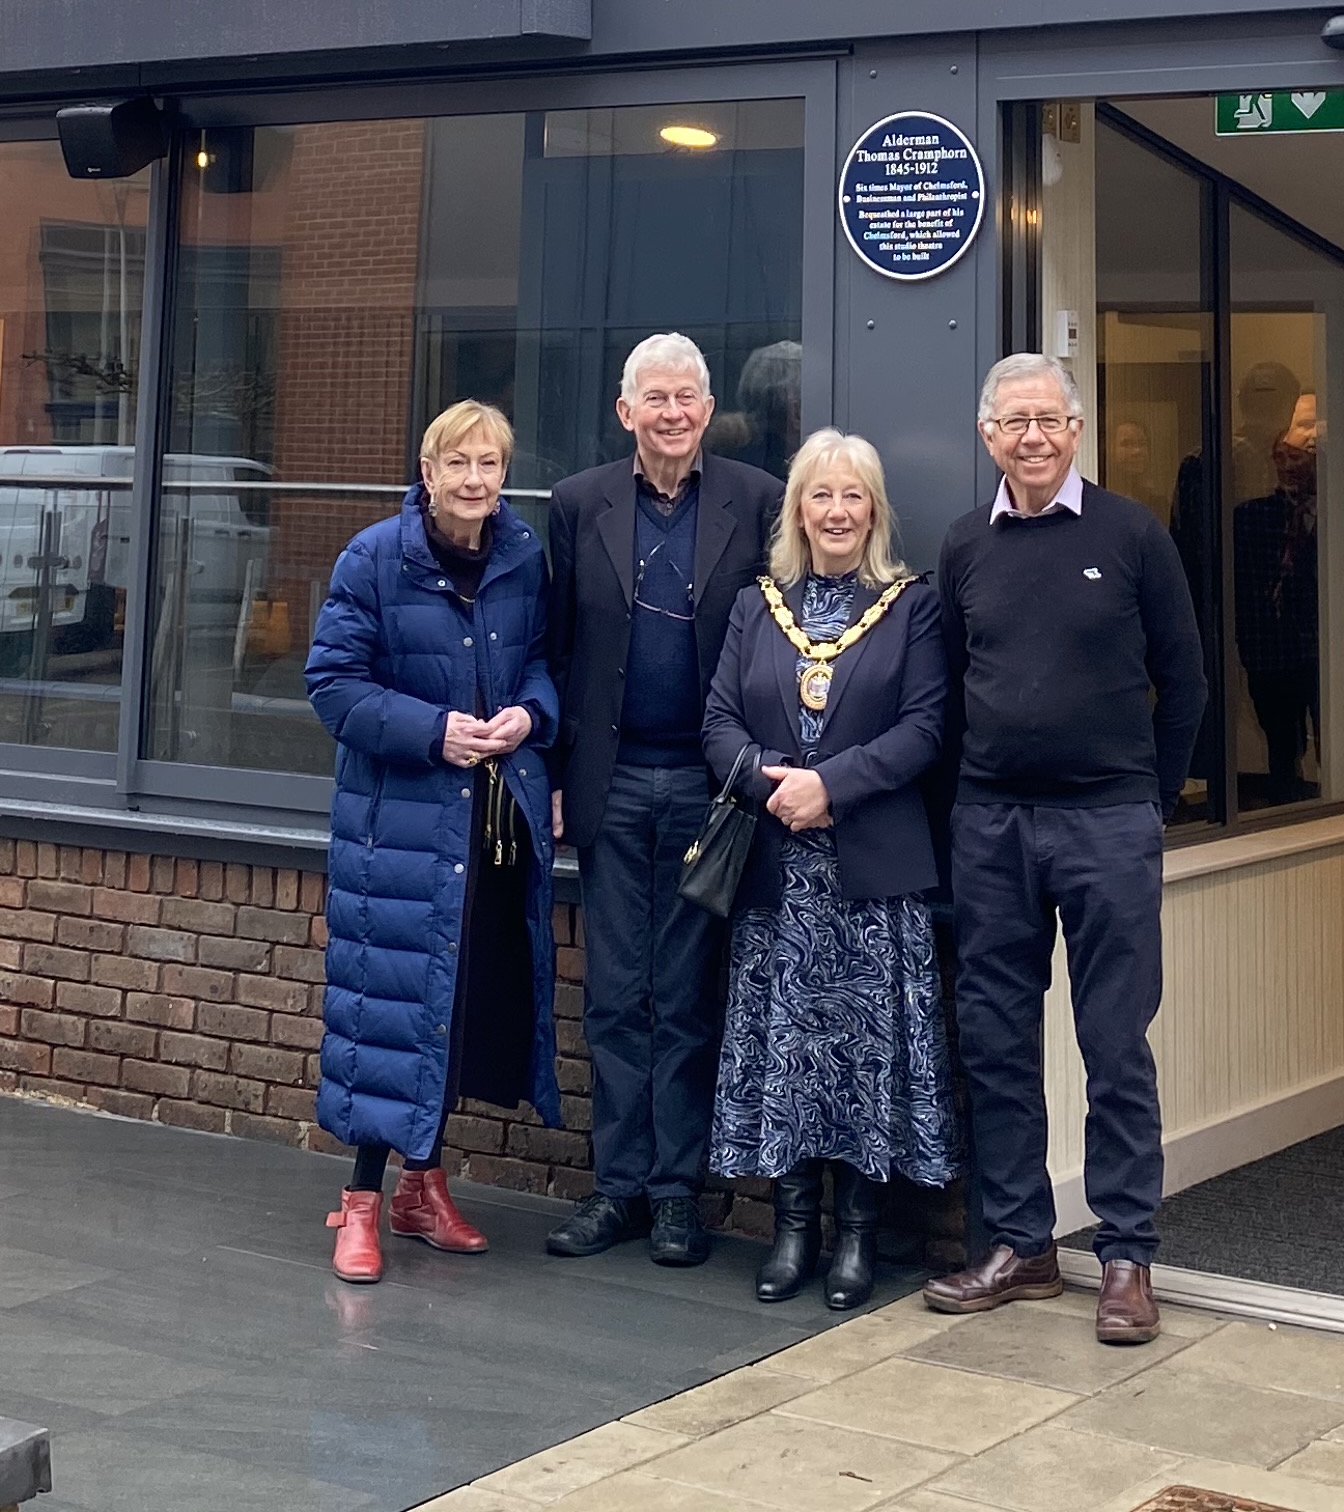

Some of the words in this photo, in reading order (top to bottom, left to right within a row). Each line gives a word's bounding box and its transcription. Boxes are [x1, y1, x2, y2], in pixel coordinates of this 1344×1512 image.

[882, 134, 940, 147] Alderman
[856, 149, 900, 162] Thomas
[902, 147, 967, 162] Cramphorn
[885, 162, 938, 176] 1845-1912
[868, 183, 889, 192] times
[889, 182, 913, 192] Mayor
[913, 182, 923, 190] of
[858, 209, 900, 219] Bequeathed
[906, 209, 925, 219] large
[925, 209, 942, 218] part
[942, 208, 952, 216] of
[952, 207, 964, 216] his
[892, 220, 904, 228] for
[944, 219, 953, 227] of
[909, 230, 932, 239] which
